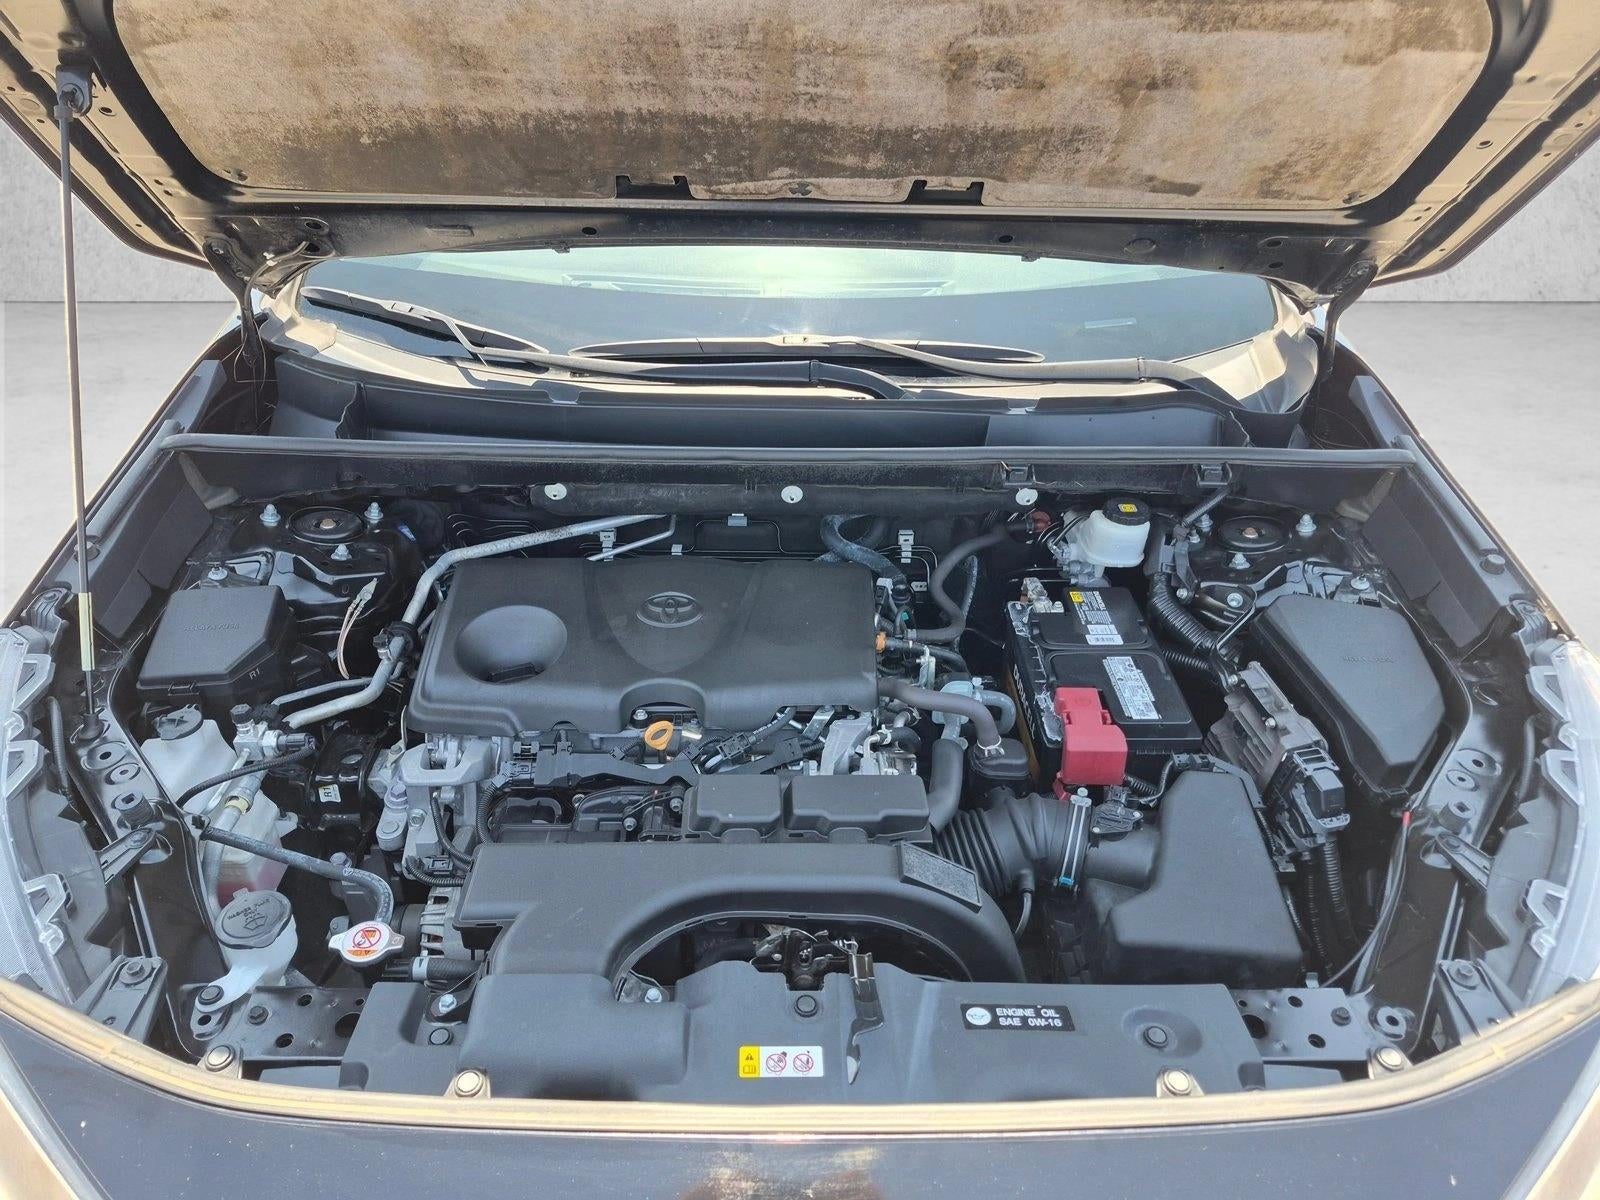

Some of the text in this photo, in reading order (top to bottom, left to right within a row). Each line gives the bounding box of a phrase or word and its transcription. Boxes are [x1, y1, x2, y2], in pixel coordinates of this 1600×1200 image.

[995, 1008, 1060, 1017] ENGINE OIL
[999, 1017, 1063, 1027] SAE 0W-16
